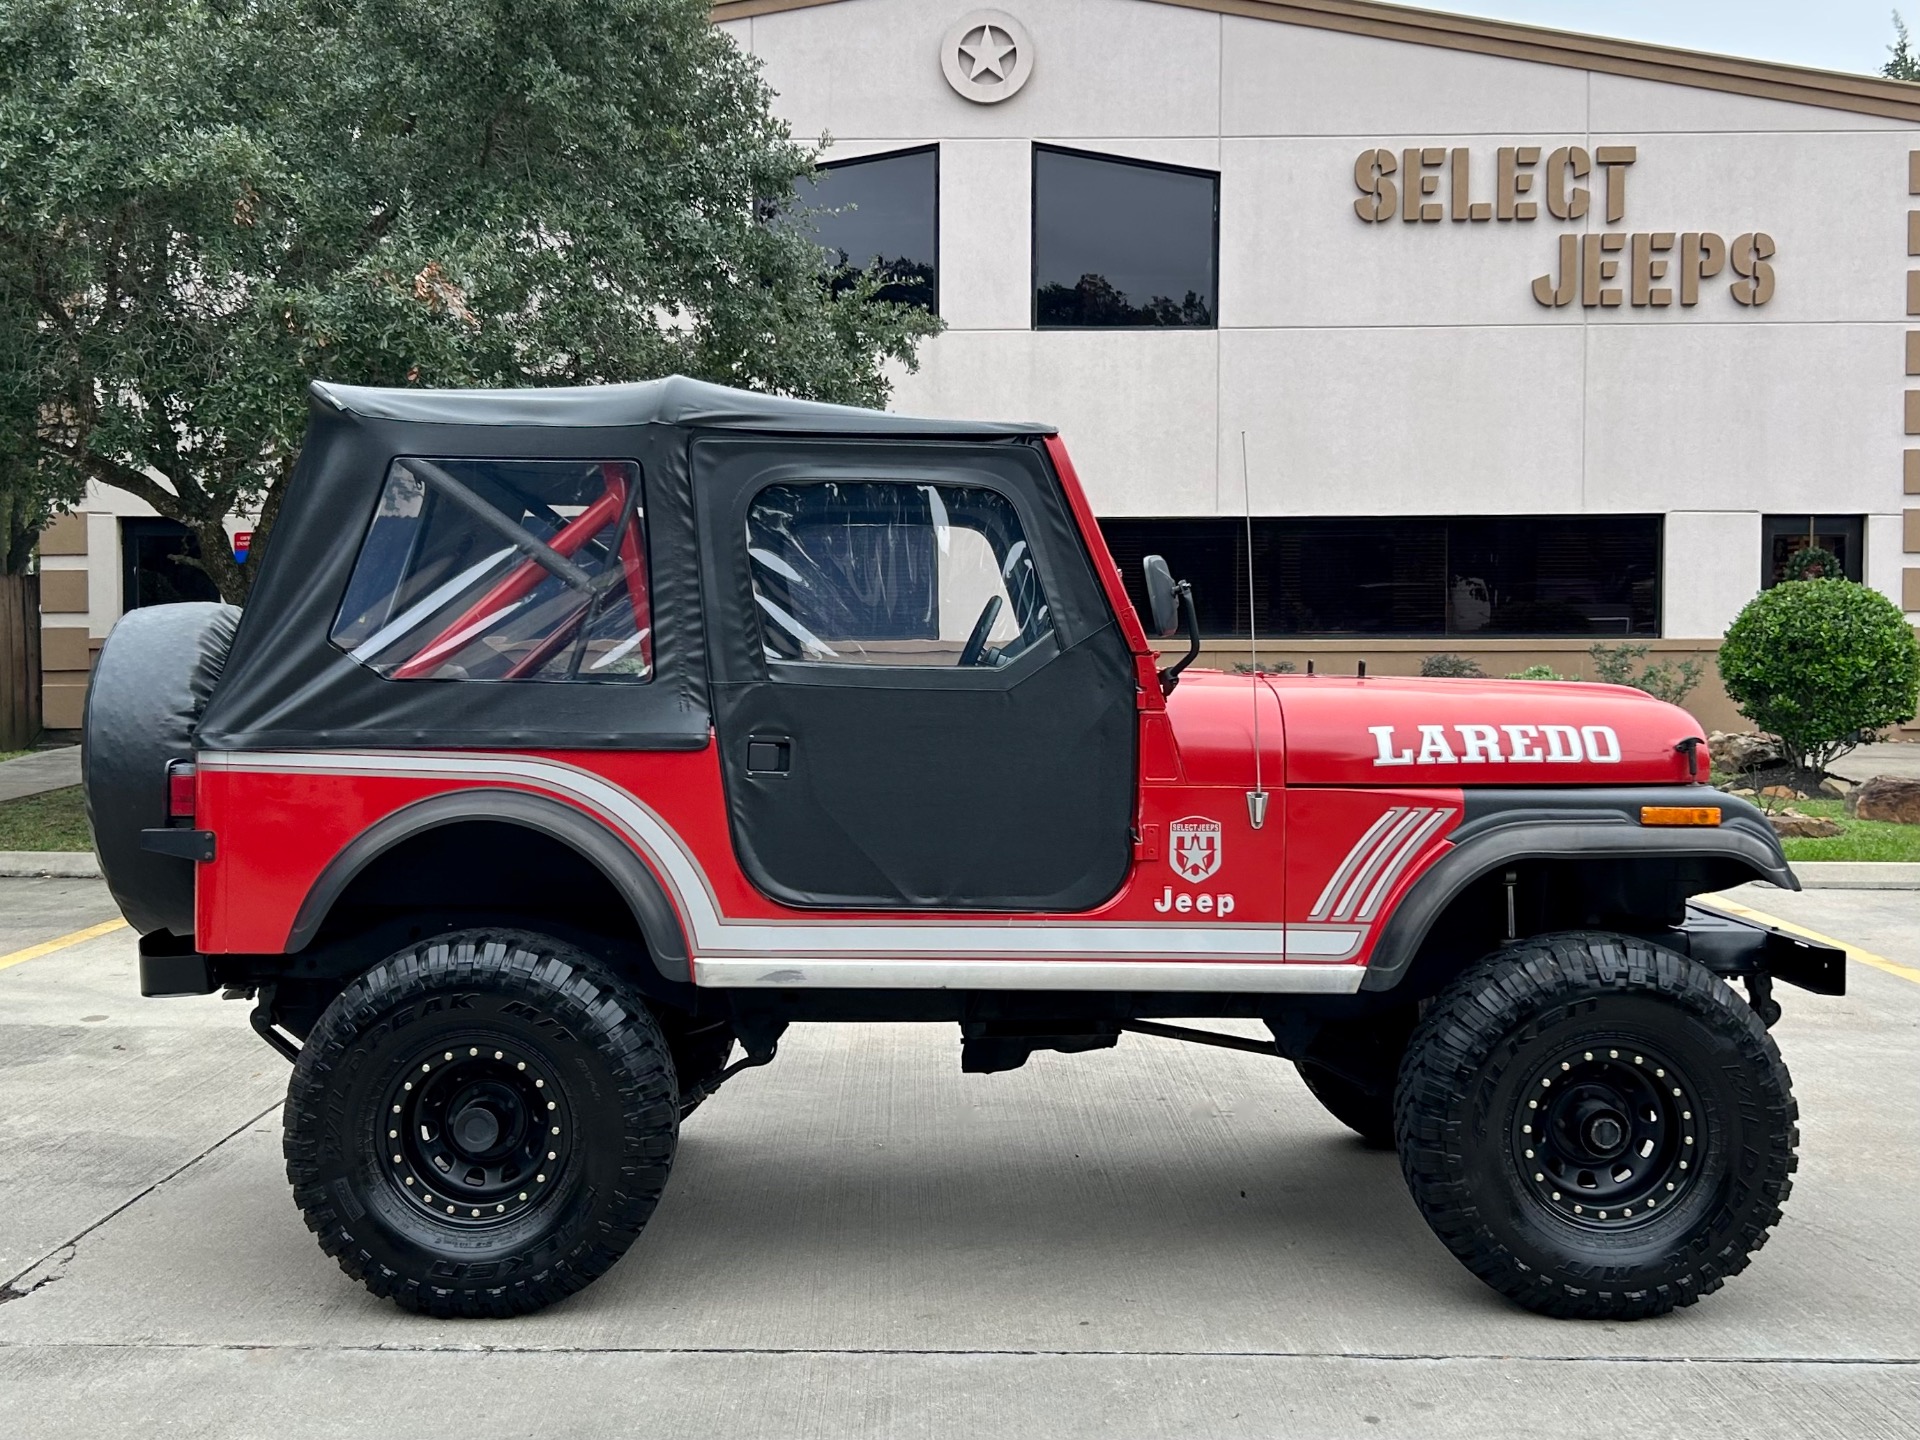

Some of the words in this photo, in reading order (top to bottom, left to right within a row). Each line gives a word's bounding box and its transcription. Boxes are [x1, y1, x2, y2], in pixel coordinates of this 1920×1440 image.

[1353, 145, 1637, 225] SELECT
[1531, 232, 1777, 308] JEEPS
[1368, 724, 1623, 767] LAREDO
[1153, 886, 1235, 918] Jeep
